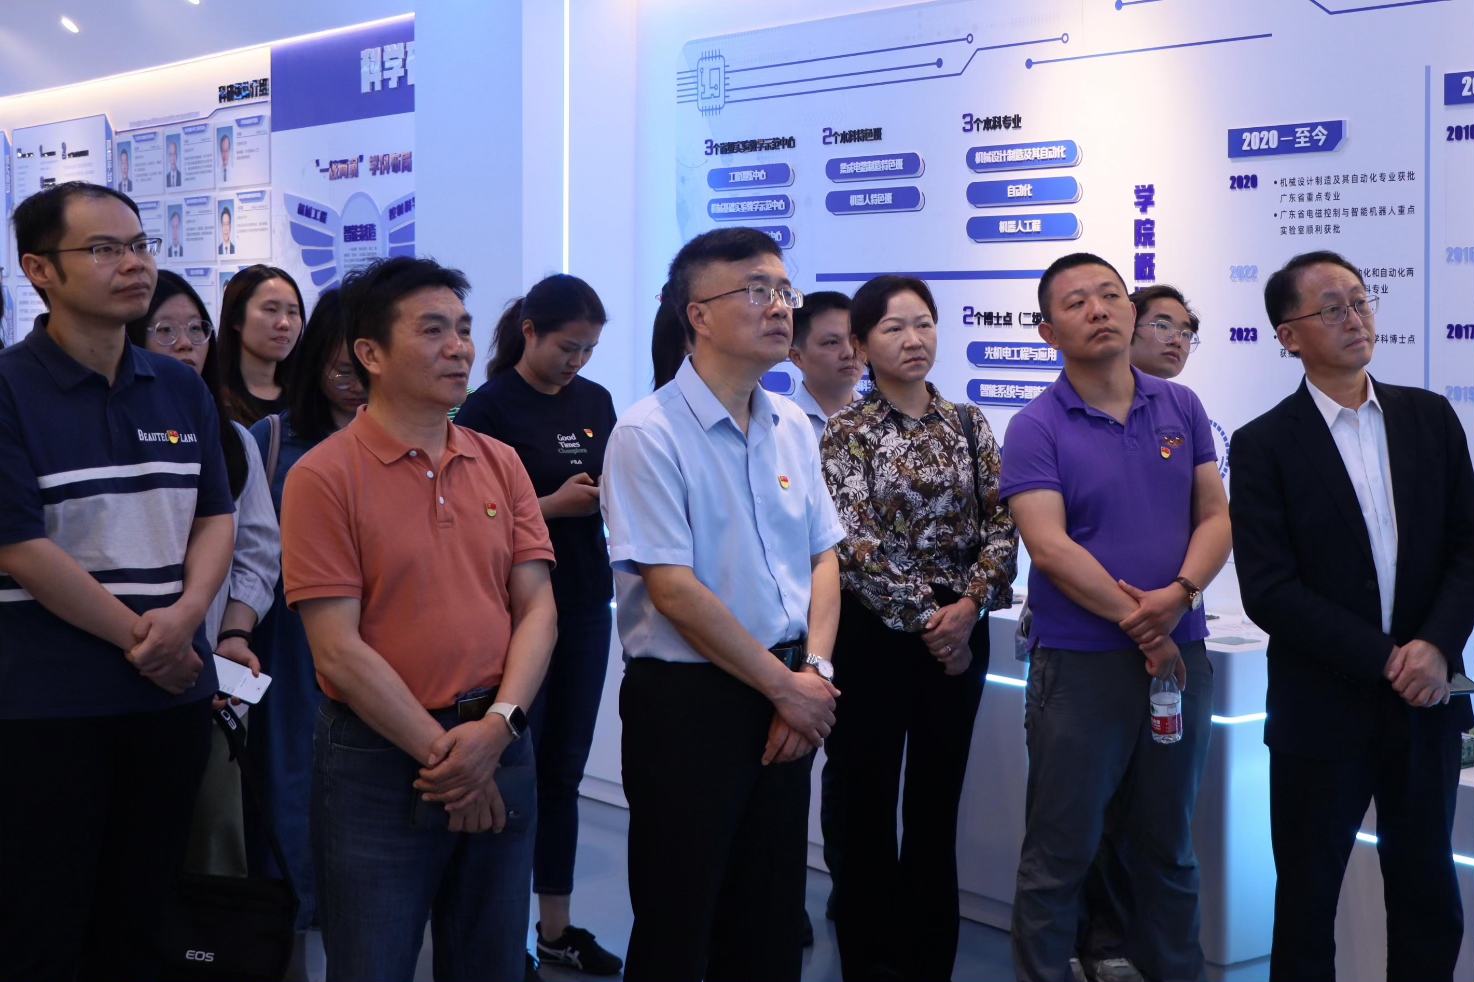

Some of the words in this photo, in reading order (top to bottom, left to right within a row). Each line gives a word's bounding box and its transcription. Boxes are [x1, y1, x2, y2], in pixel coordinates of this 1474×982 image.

[962, 113, 1022, 132] 3个本科专业
[975, 145, 1067, 164] 机械设计制造及其自动化
[1230, 174, 1258, 190] 2020
[1279, 170, 1416, 188] 机械设计制造及其自动化专业获批
[1007, 184, 1033, 198] 自动化
[1279, 190, 1341, 204] 广东省重点专业
[1279, 204, 1416, 220] 广东省电磁控制与智能机器人重点
[998, 218, 1042, 234] 机器人工程
[1279, 224, 1341, 236] 实验室顺利获批
[1134, 184, 1155, 293] 学院概
[1230, 328, 1258, 343] 2023
[984, 346, 1058, 362] 光机电工程与应用
[980, 384, 1046, 400] 智能系统与智能
[557, 433, 577, 441] Good
[185, 949, 215, 962] EOS
